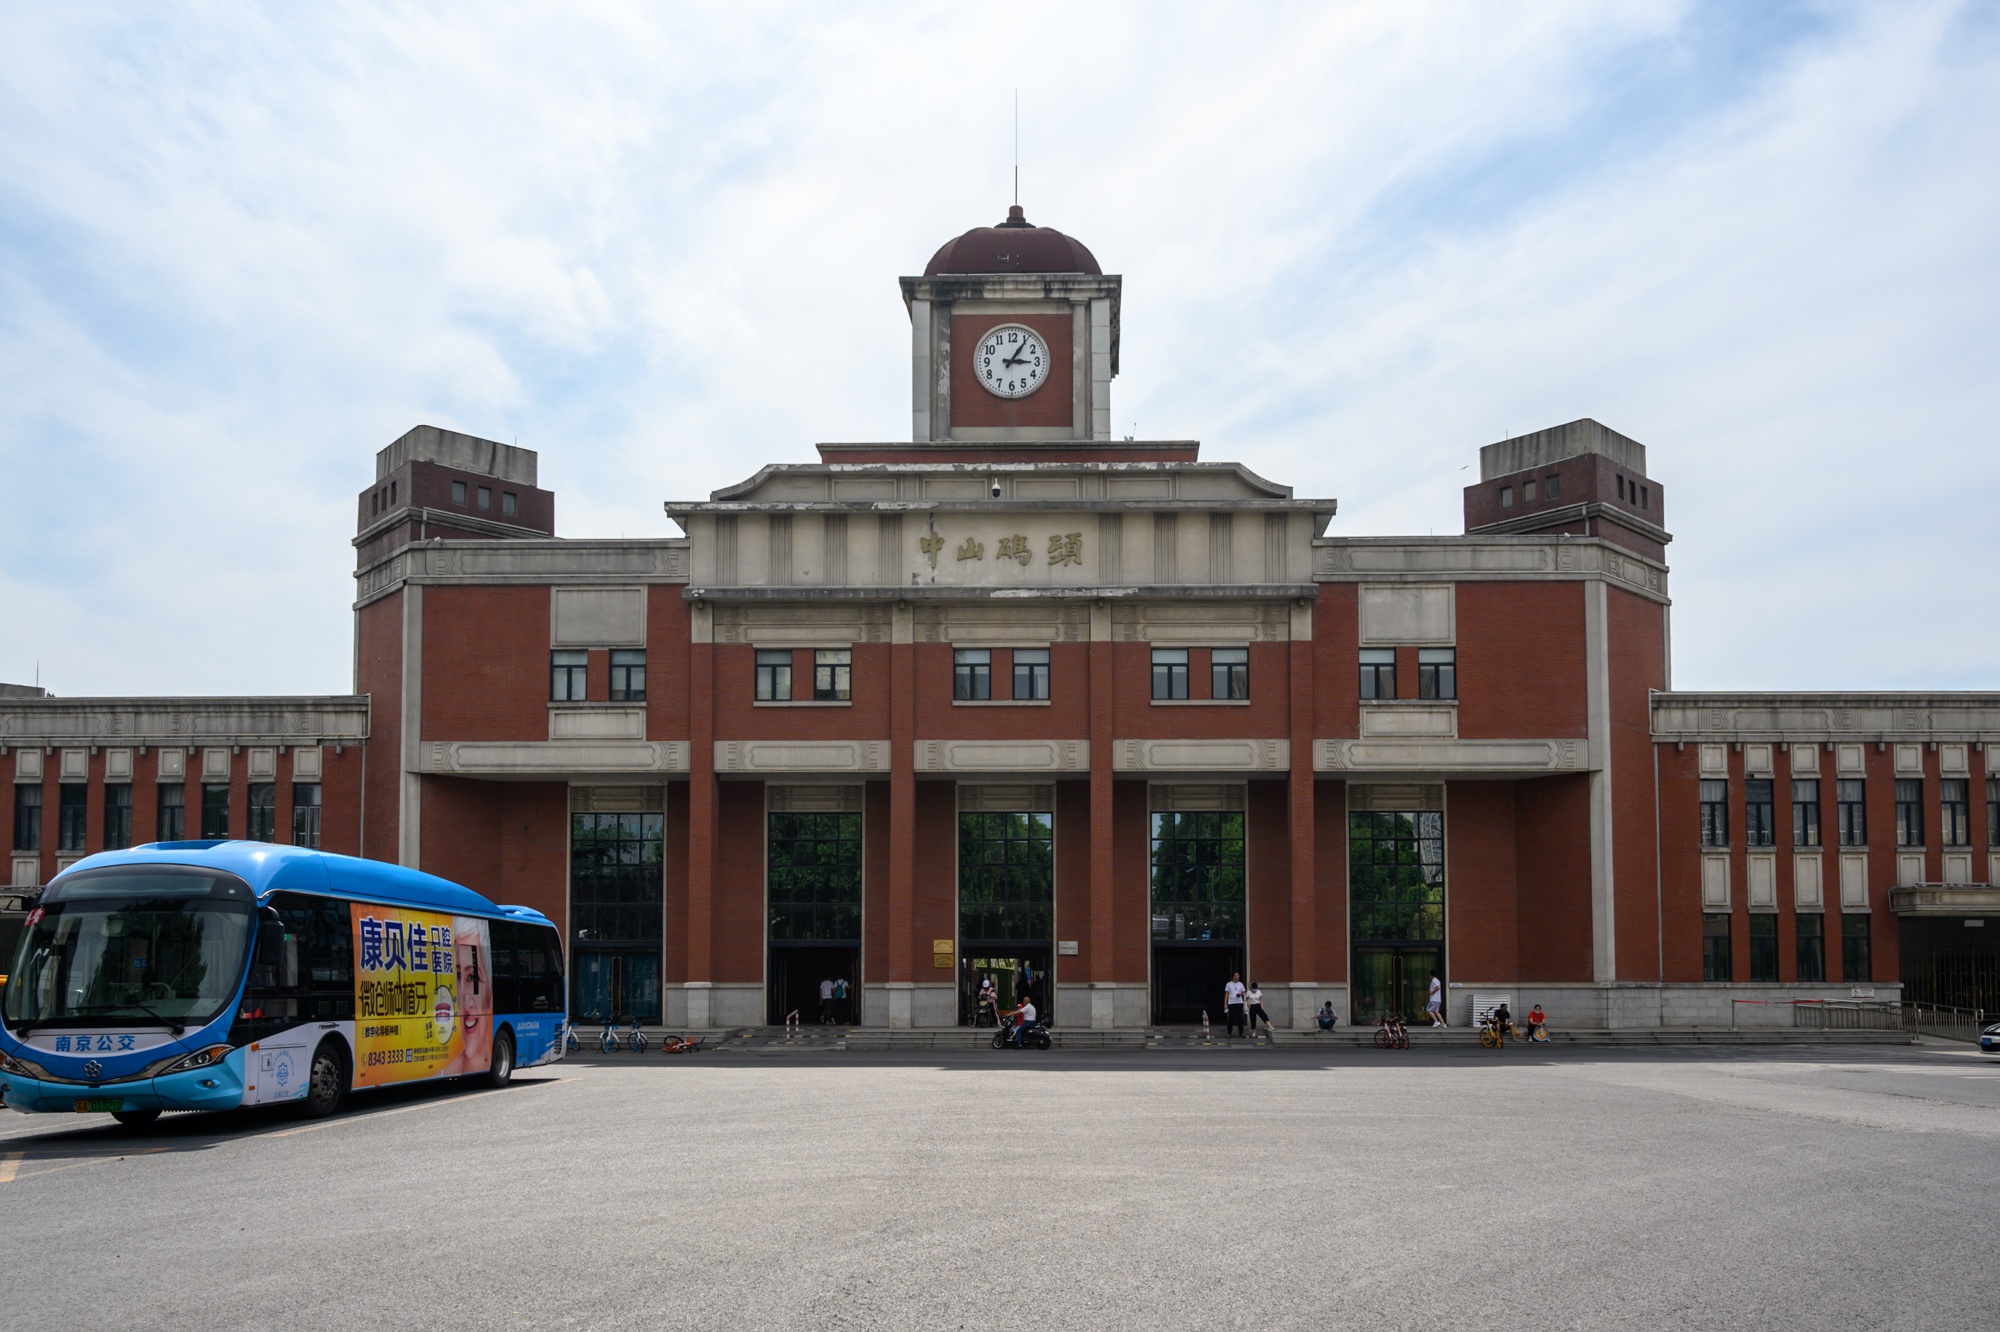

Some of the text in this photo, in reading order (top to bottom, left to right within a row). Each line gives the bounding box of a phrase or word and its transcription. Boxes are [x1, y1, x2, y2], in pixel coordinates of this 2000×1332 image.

[996, 335, 1003, 345] 11
[1008, 333, 1018, 343] 12
[985, 345, 995, 355] 10
[1030, 344, 1036, 354] 2
[984, 357, 990, 367] 9
[1034, 356, 1040, 367] 3
[986, 369, 992, 379] 8
[1030, 369, 1037, 379] 4
[996, 378, 1002, 388] 7
[1008, 381, 1015, 391] 6
[1020, 378, 1027, 388] 5
[920, 531, 1083, 570] 中山碼頭
[430, 926, 452, 948] 口腔
[359, 916, 429, 972] 康贝佳
[431, 950, 453, 974] 医院
[358, 981, 428, 1017] 微创种植牙
[55, 1034, 136, 1052] 南京公交
[368, 1051, 386, 1067] 8343
[387, 1049, 404, 1064] 3333
